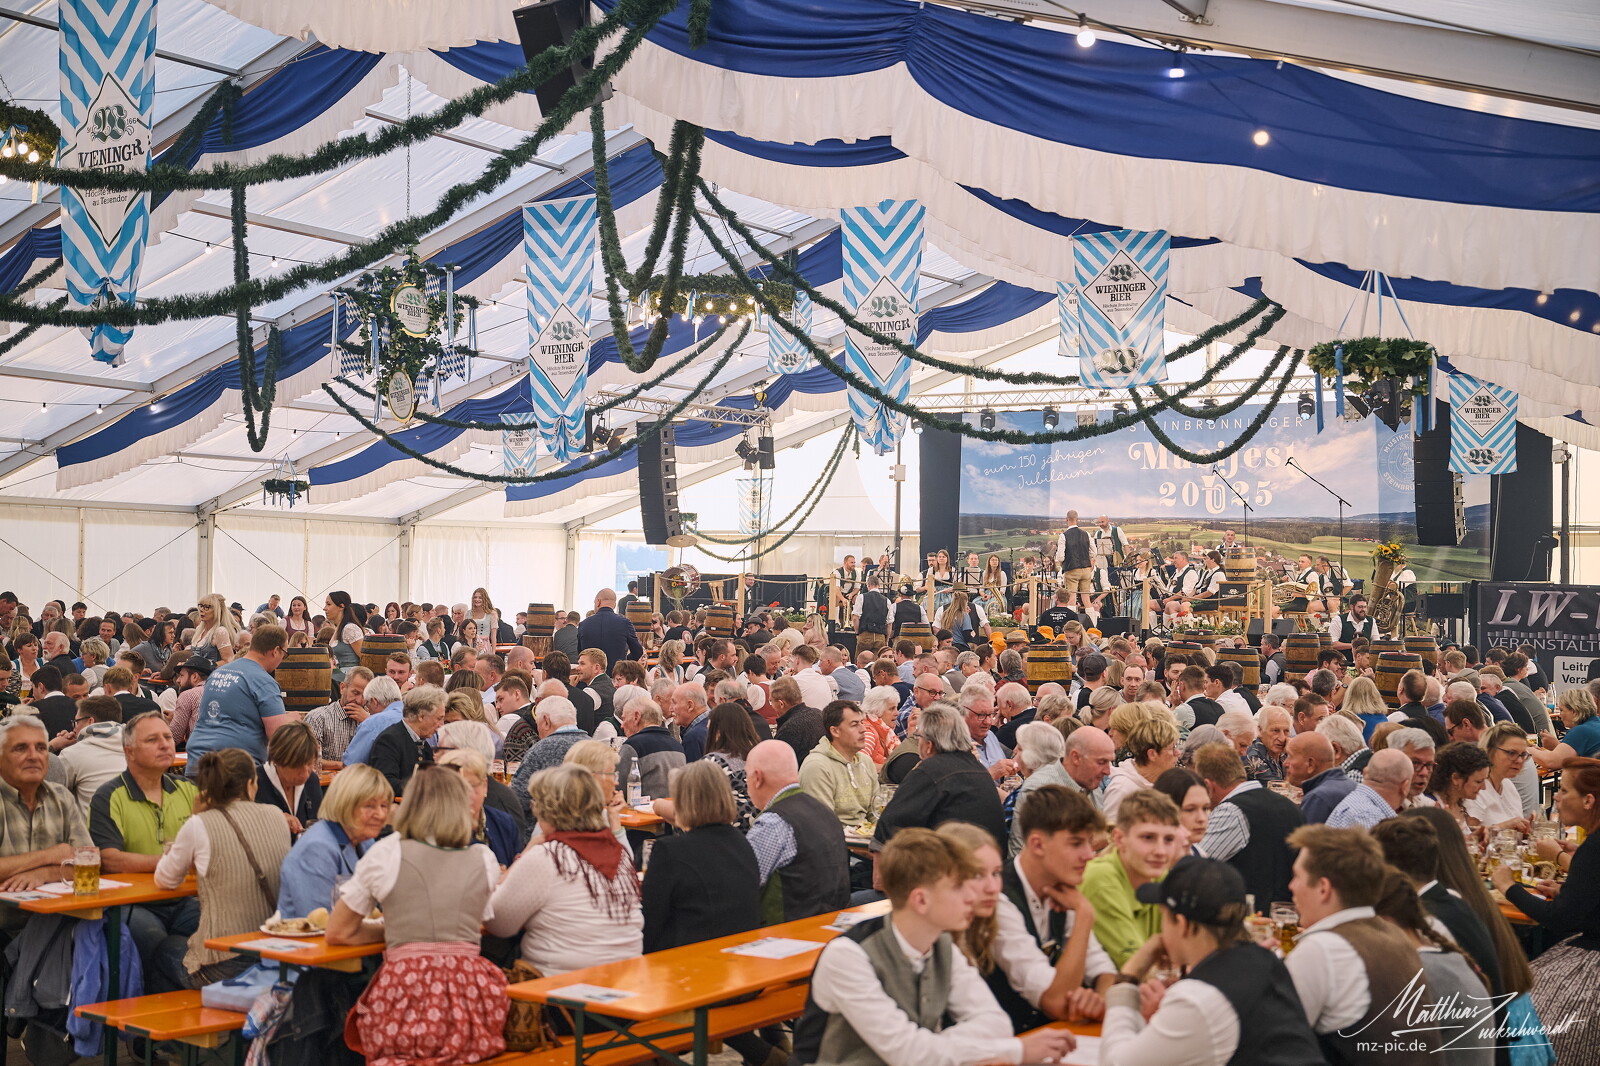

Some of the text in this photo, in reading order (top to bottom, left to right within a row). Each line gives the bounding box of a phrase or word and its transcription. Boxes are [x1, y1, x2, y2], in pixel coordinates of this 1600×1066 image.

[1095, 282, 1147, 294] WIENINGER
[1110, 293, 1132, 302] BIER
[554, 353, 575, 364] BIER
[1383, 433, 1410, 453] MUSIKK
[1018, 454, 1036, 468] 150
[1040, 446, 1106, 470] jährigen
[1018, 468, 1094, 490] Jubiläum
[1487, 589, 1600, 629] LW-
[1487, 637, 1600, 652] VERANSTALT
[1561, 673, 1588, 685] Vera
